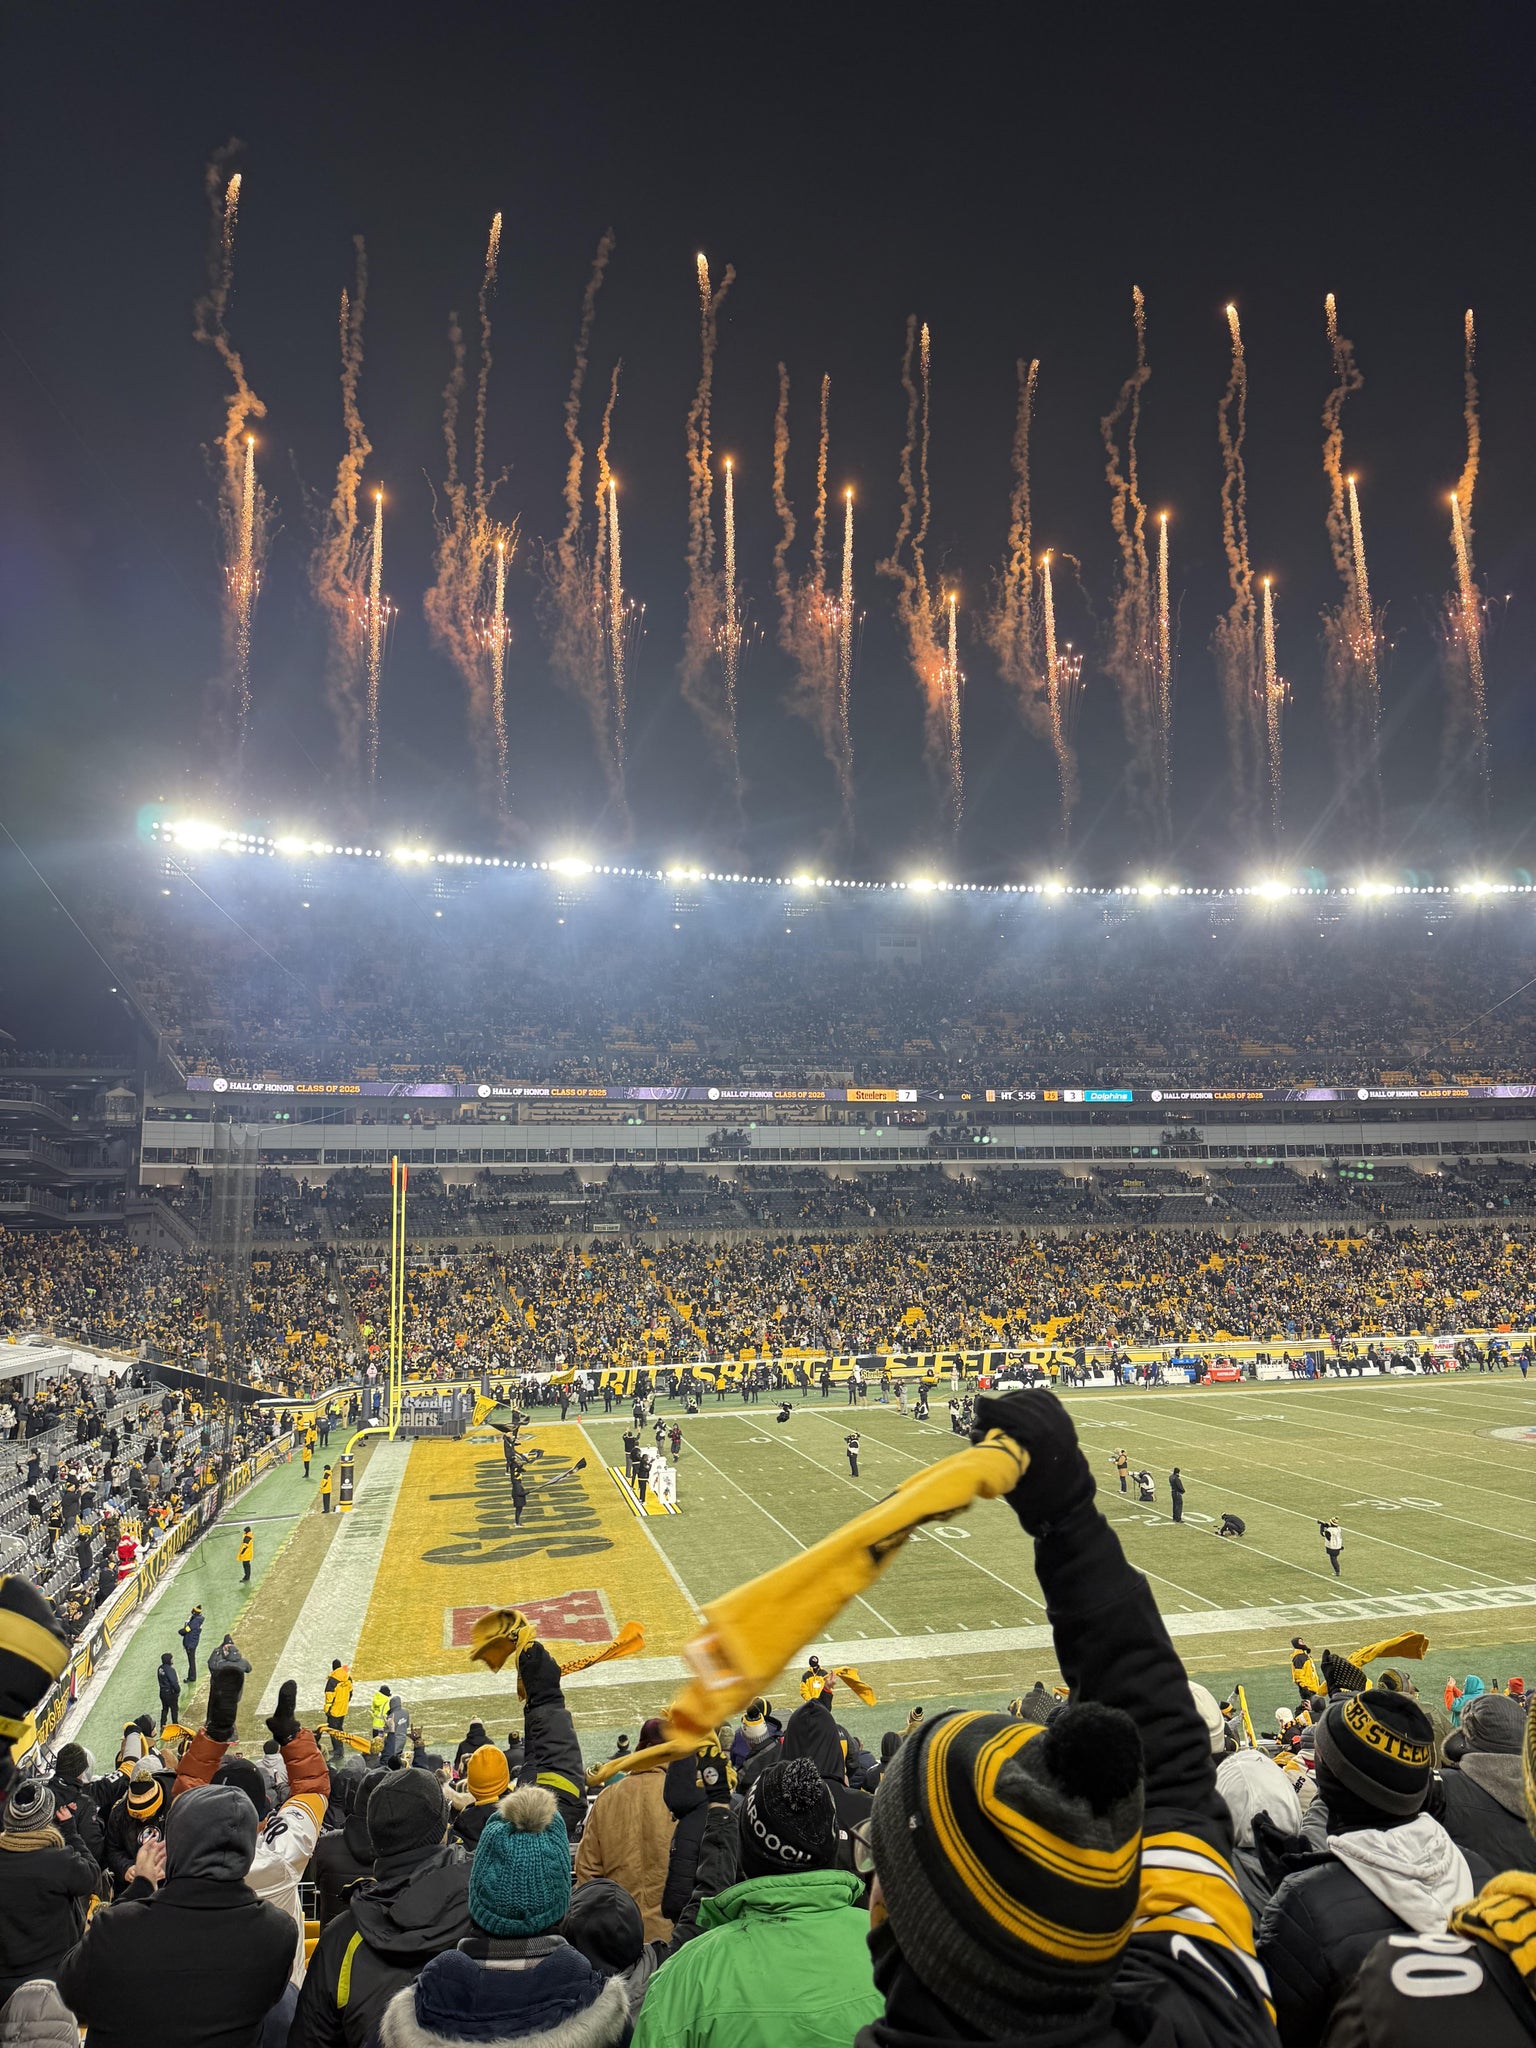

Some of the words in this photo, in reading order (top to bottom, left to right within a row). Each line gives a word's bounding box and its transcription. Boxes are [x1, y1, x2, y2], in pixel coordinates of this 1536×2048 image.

[229, 1082, 251, 1090] HALL
[253, 1083, 264, 1091] OF
[265, 1084, 294, 1092] HONOR
[326, 1085, 338, 1093] OF
[492, 1087, 512, 1095] HALL
[513, 1087, 523, 1095] OF
[524, 1088, 550, 1096] HONOR
[551, 1088, 575, 1096] CLASS
[720, 1090, 739, 1098] HALL
[739, 1090, 749, 1098] OF
[749, 1090, 773, 1098] HONOR
[855, 1091, 887, 1100] Steelers
[905, 1092, 910, 1100] 7
[1018, 1092, 1036, 1100] 5:56
[420, 1455, 615, 1565] Steelers
[1267, 1589, 1535, 1623] CHANGE
